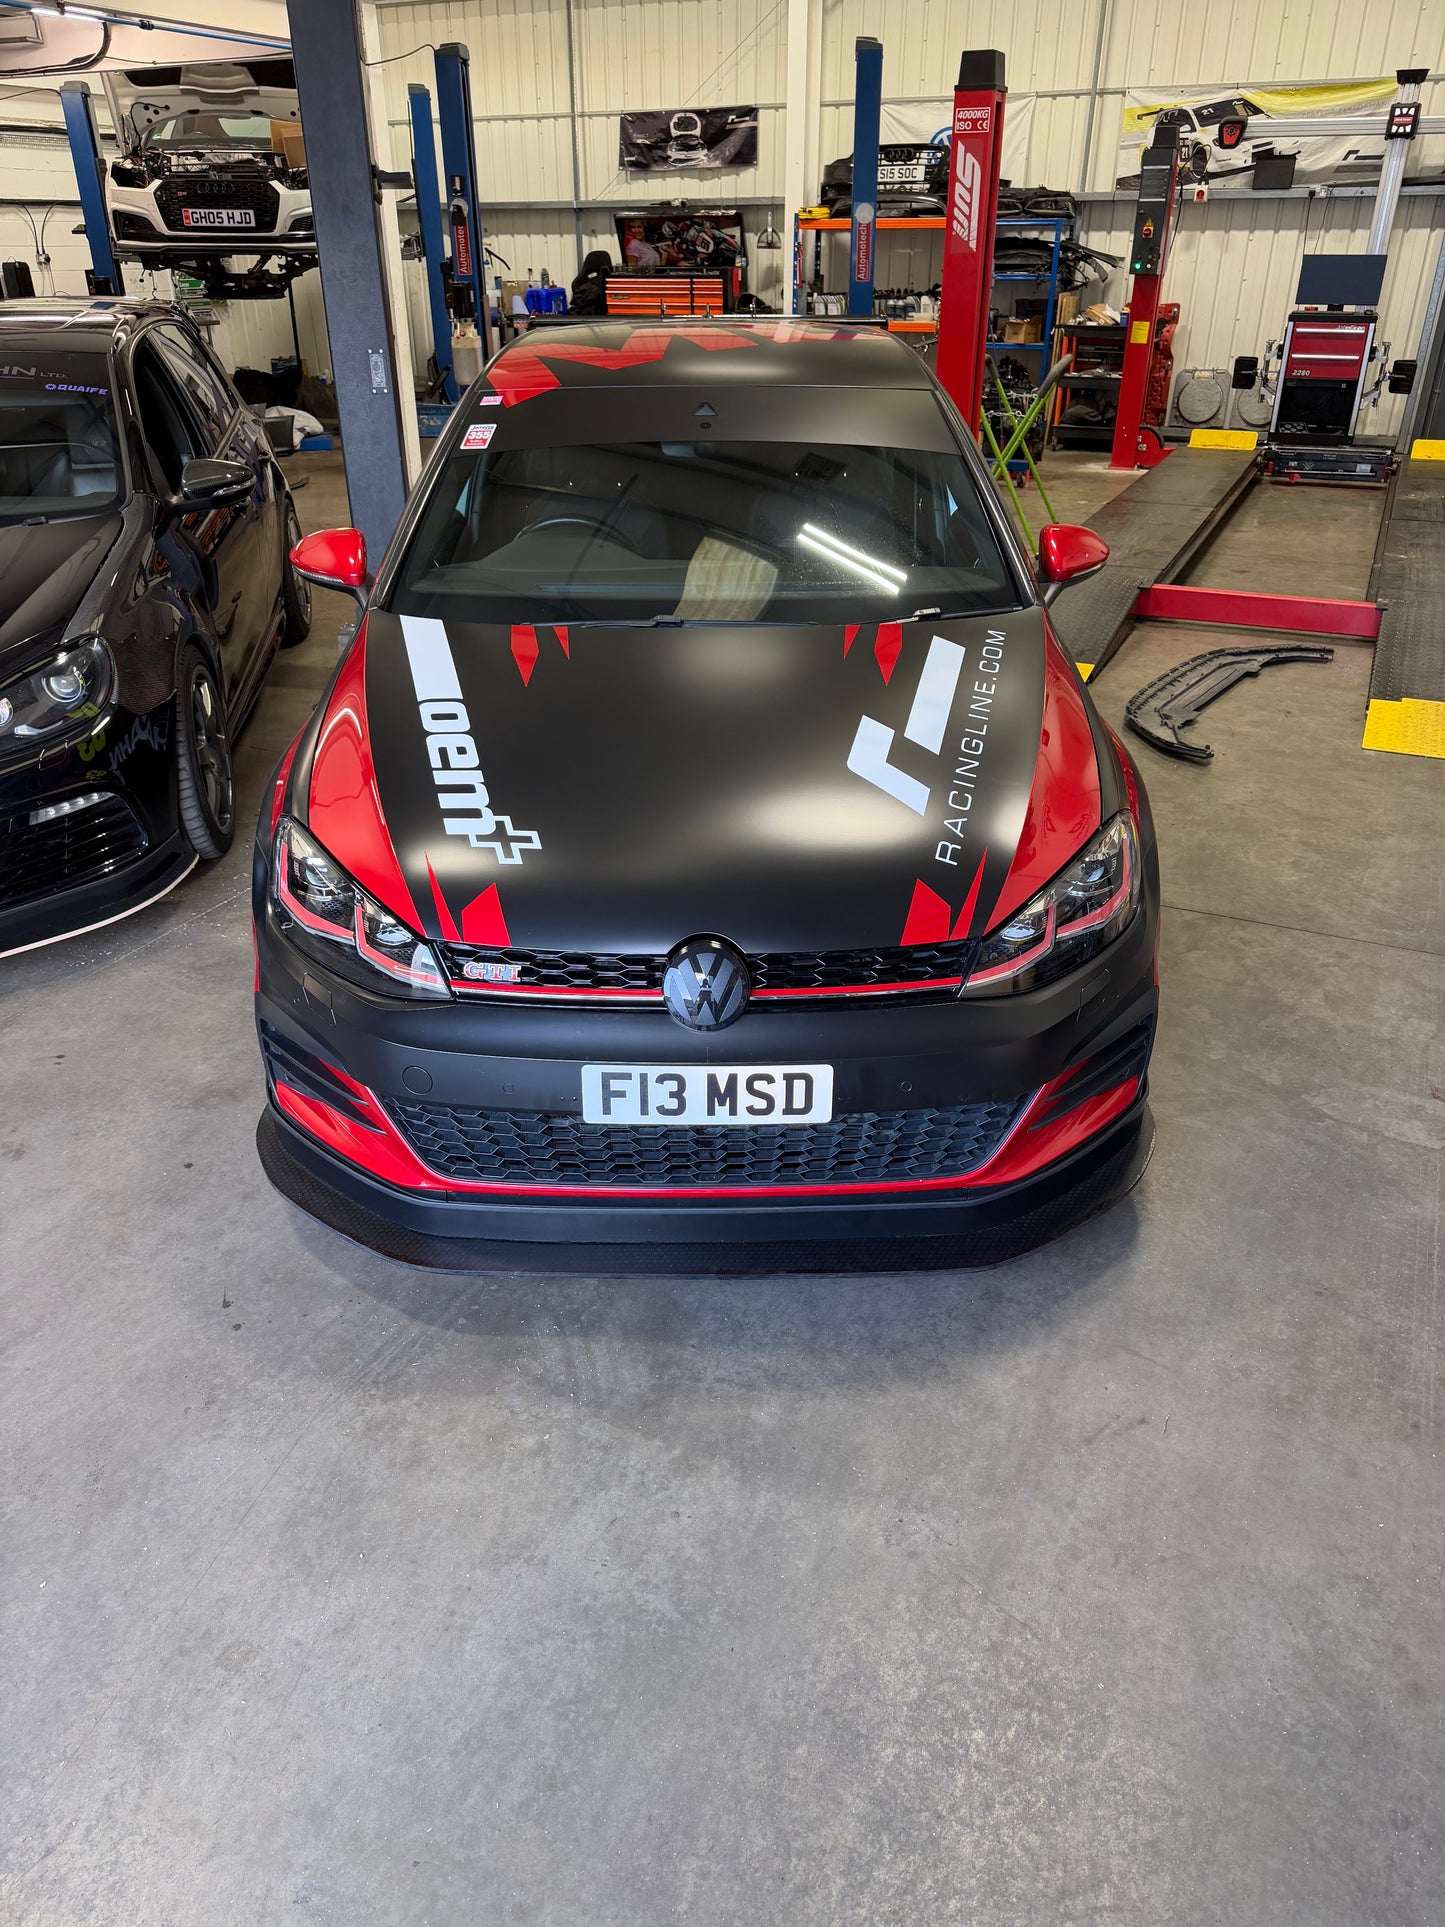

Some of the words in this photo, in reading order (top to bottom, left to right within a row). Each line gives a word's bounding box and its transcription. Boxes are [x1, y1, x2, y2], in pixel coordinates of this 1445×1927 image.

[957, 109, 989, 119] 4000KG
[1201, 107, 1214, 115] 21
[956, 121, 972, 130] ISO
[1181, 146, 1188, 159] 21
[877, 168, 895, 180] S15
[897, 167, 918, 179] SOC
[190, 211, 224, 224] GH05
[226, 211, 252, 225] HJD
[457, 225, 468, 273] Automotec
[858, 224, 868, 279] Automotech
[57, 384, 108, 395] QUAIFE
[468, 431, 491, 440] 355
[935, 629, 1006, 866] RACINGLINE.COM
[463, 962, 521, 982] GTI
[600, 1071, 687, 1117] F13
[706, 1072, 814, 1117] MSD
